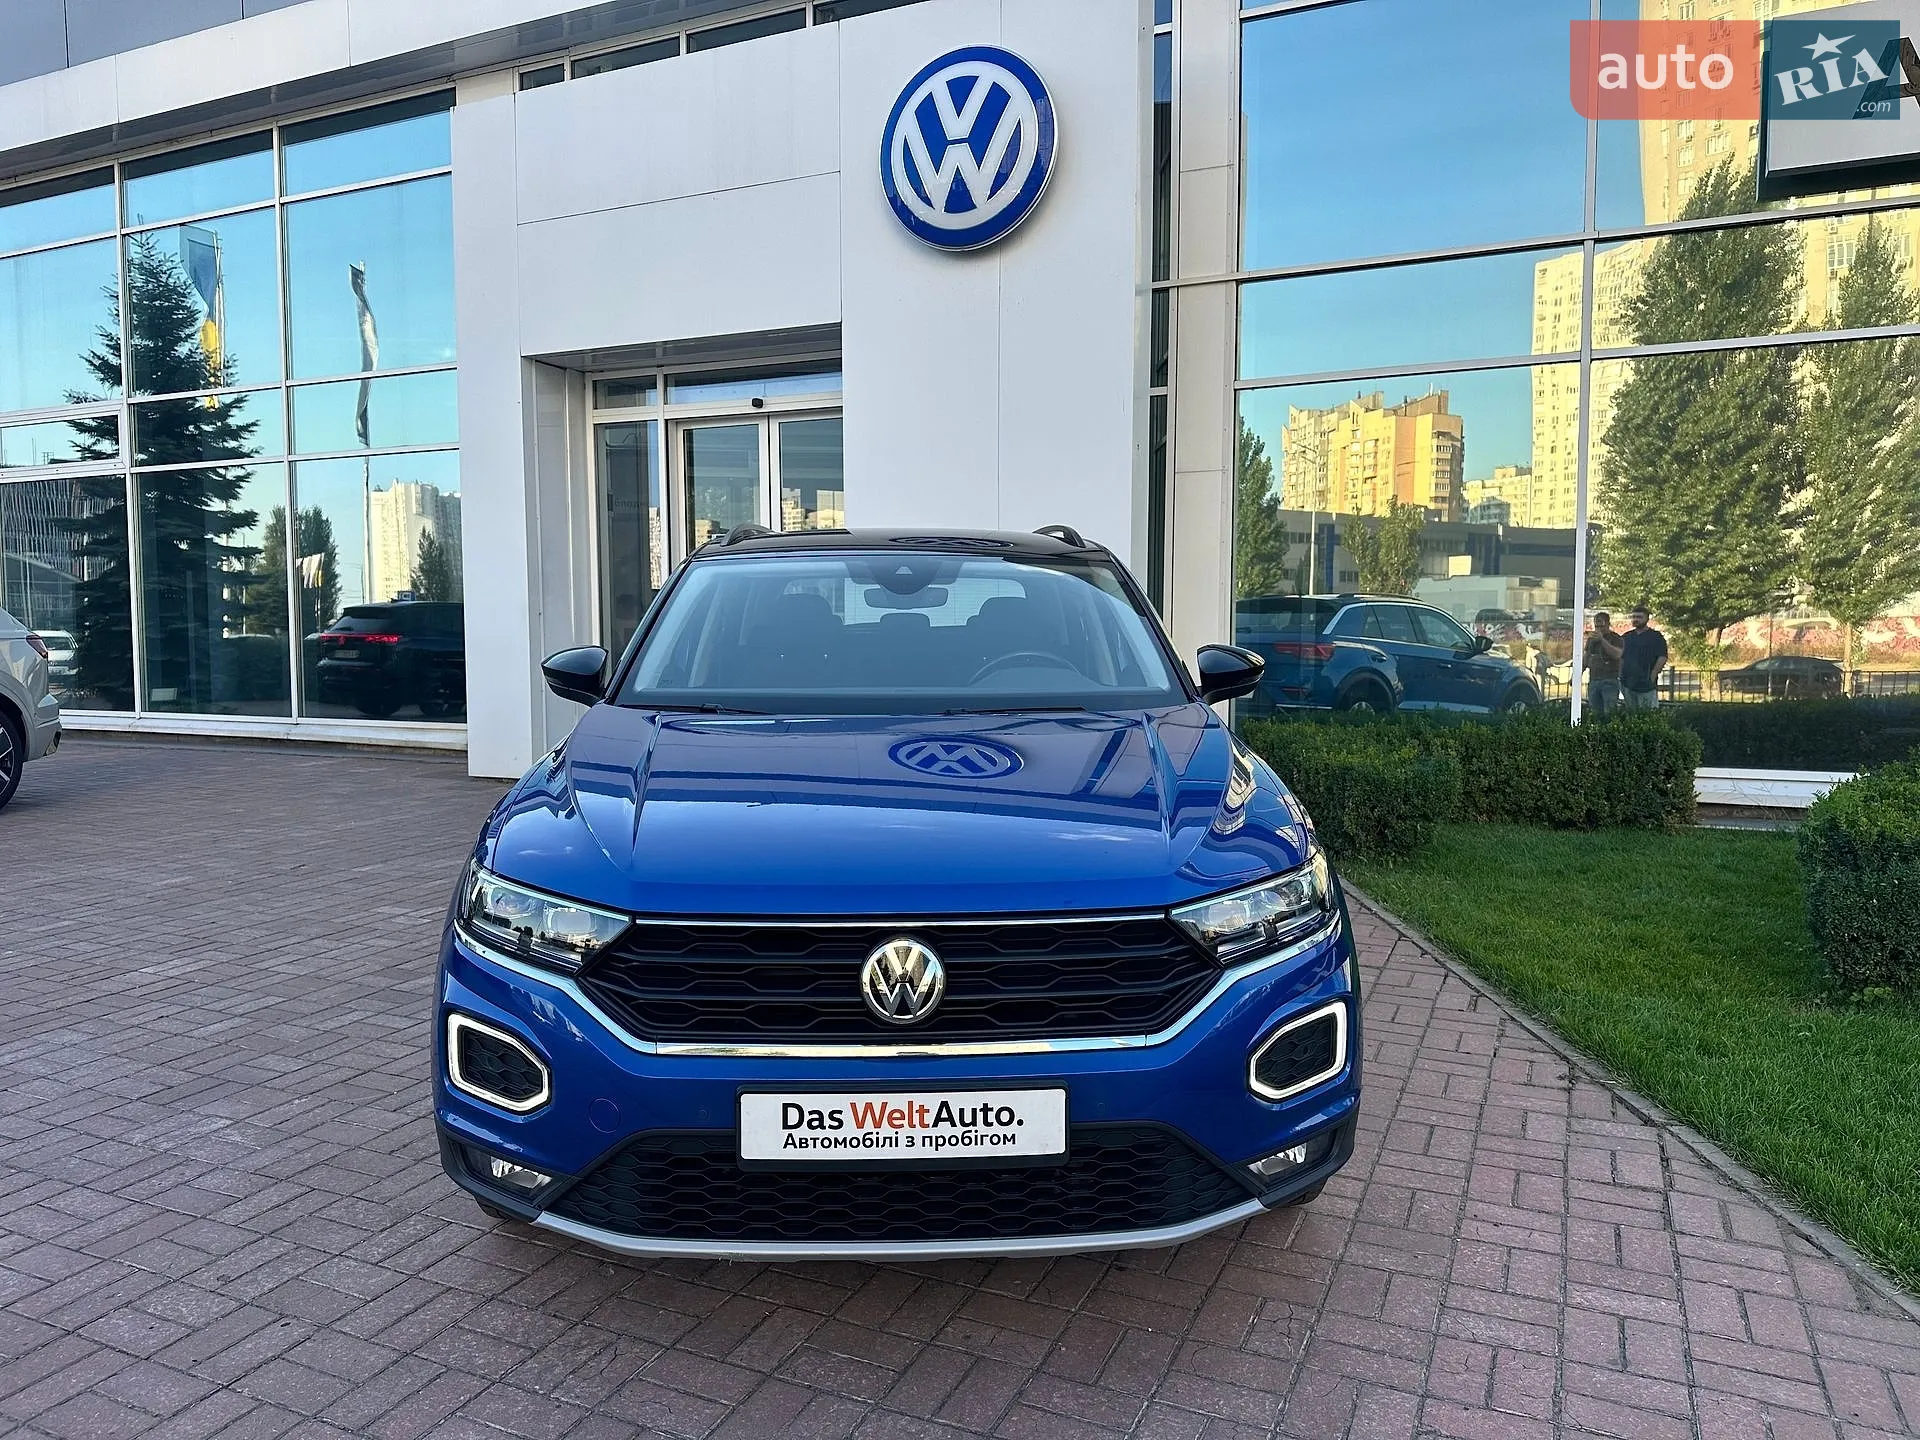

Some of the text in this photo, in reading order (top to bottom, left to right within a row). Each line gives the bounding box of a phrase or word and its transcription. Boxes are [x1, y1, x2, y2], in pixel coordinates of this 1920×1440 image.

[889, 60, 1039, 230] VW
[864, 940, 942, 1021] VW
[782, 1100, 1024, 1130] Das WeltAuto.
[783, 1130, 1016, 1151] Автомобілі з пробігом
